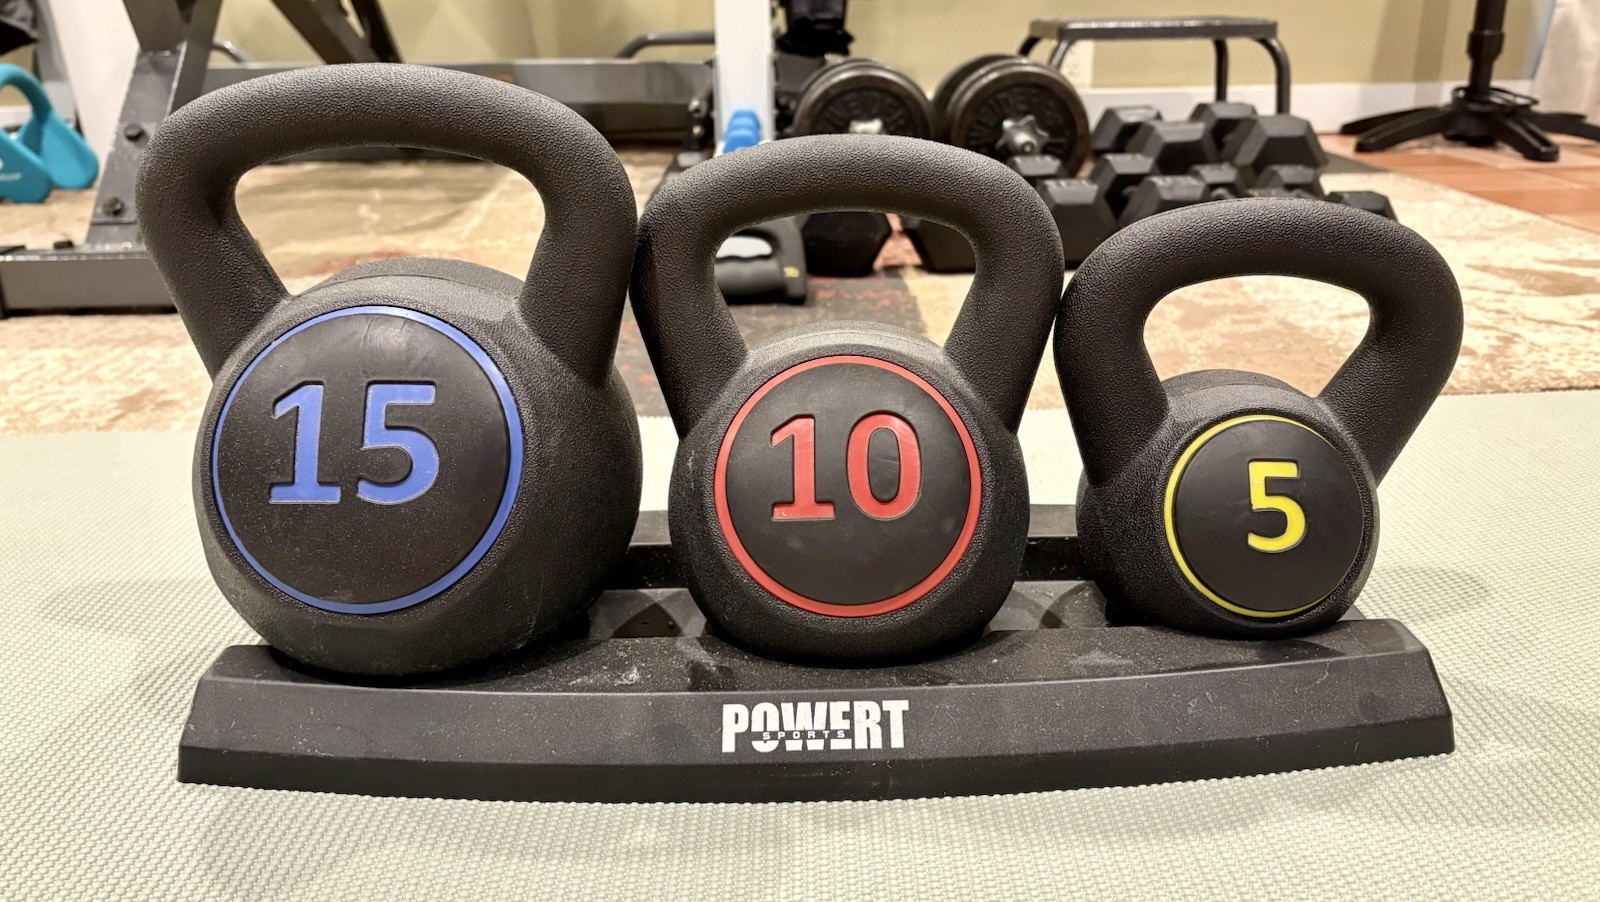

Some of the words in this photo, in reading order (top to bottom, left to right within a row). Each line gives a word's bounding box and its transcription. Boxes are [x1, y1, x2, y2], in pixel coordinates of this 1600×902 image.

[269, 381, 440, 505] 15
[771, 411, 923, 522] 10
[1246, 459, 1307, 554] 5
[722, 700, 909, 753] POWERT
[762, 730, 845, 740] SPORTS
